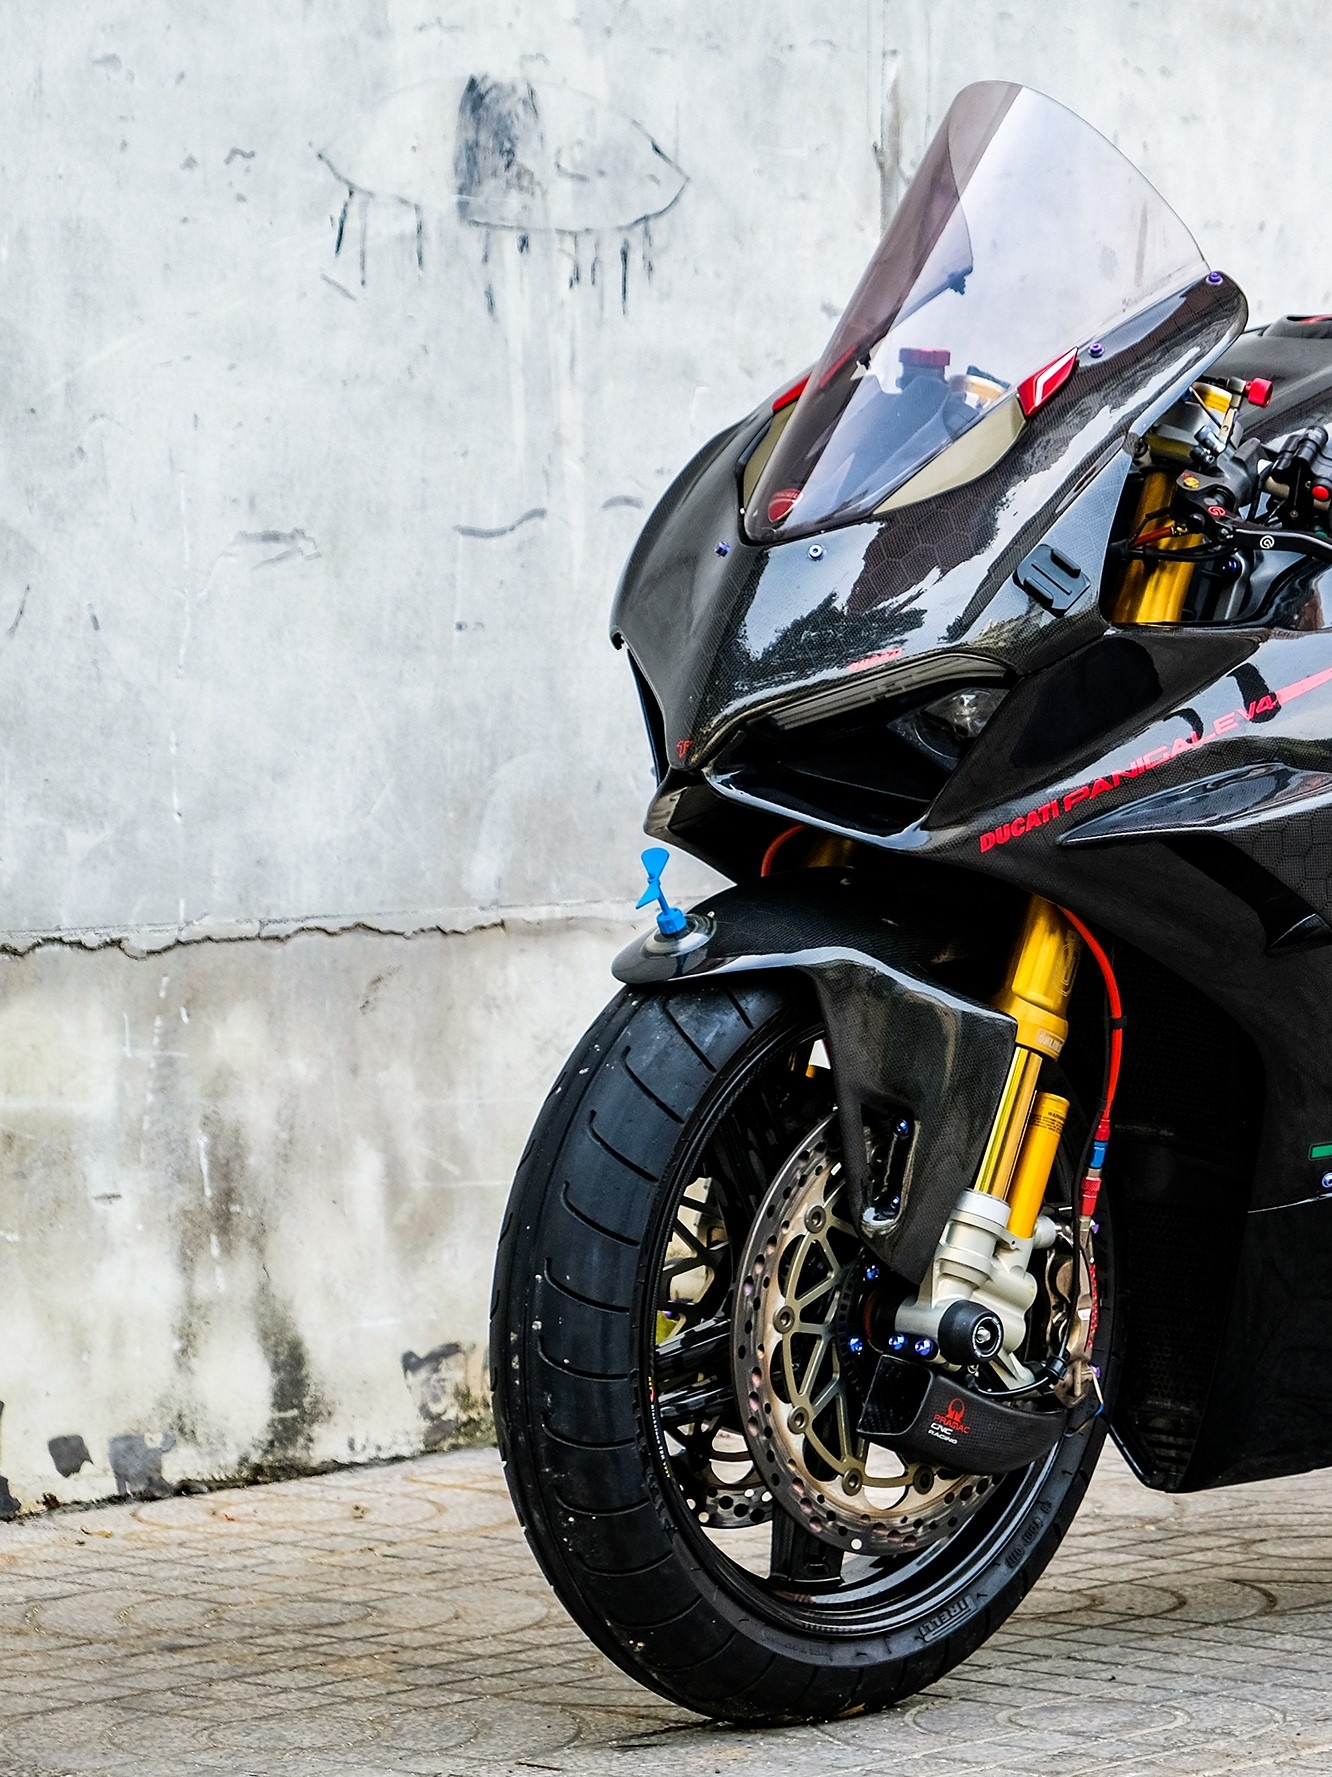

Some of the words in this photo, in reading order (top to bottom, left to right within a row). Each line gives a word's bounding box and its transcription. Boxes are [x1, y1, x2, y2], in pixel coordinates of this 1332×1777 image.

[979, 799, 1061, 854] DUCATI
[1062, 711, 1239, 813] PANIGALE
[1236, 694, 1280, 722] V4
[927, 1429, 959, 1445] RACING
[933, 1413, 971, 1435] PRAMAC
[917, 1594, 978, 1643] PIRELLI
